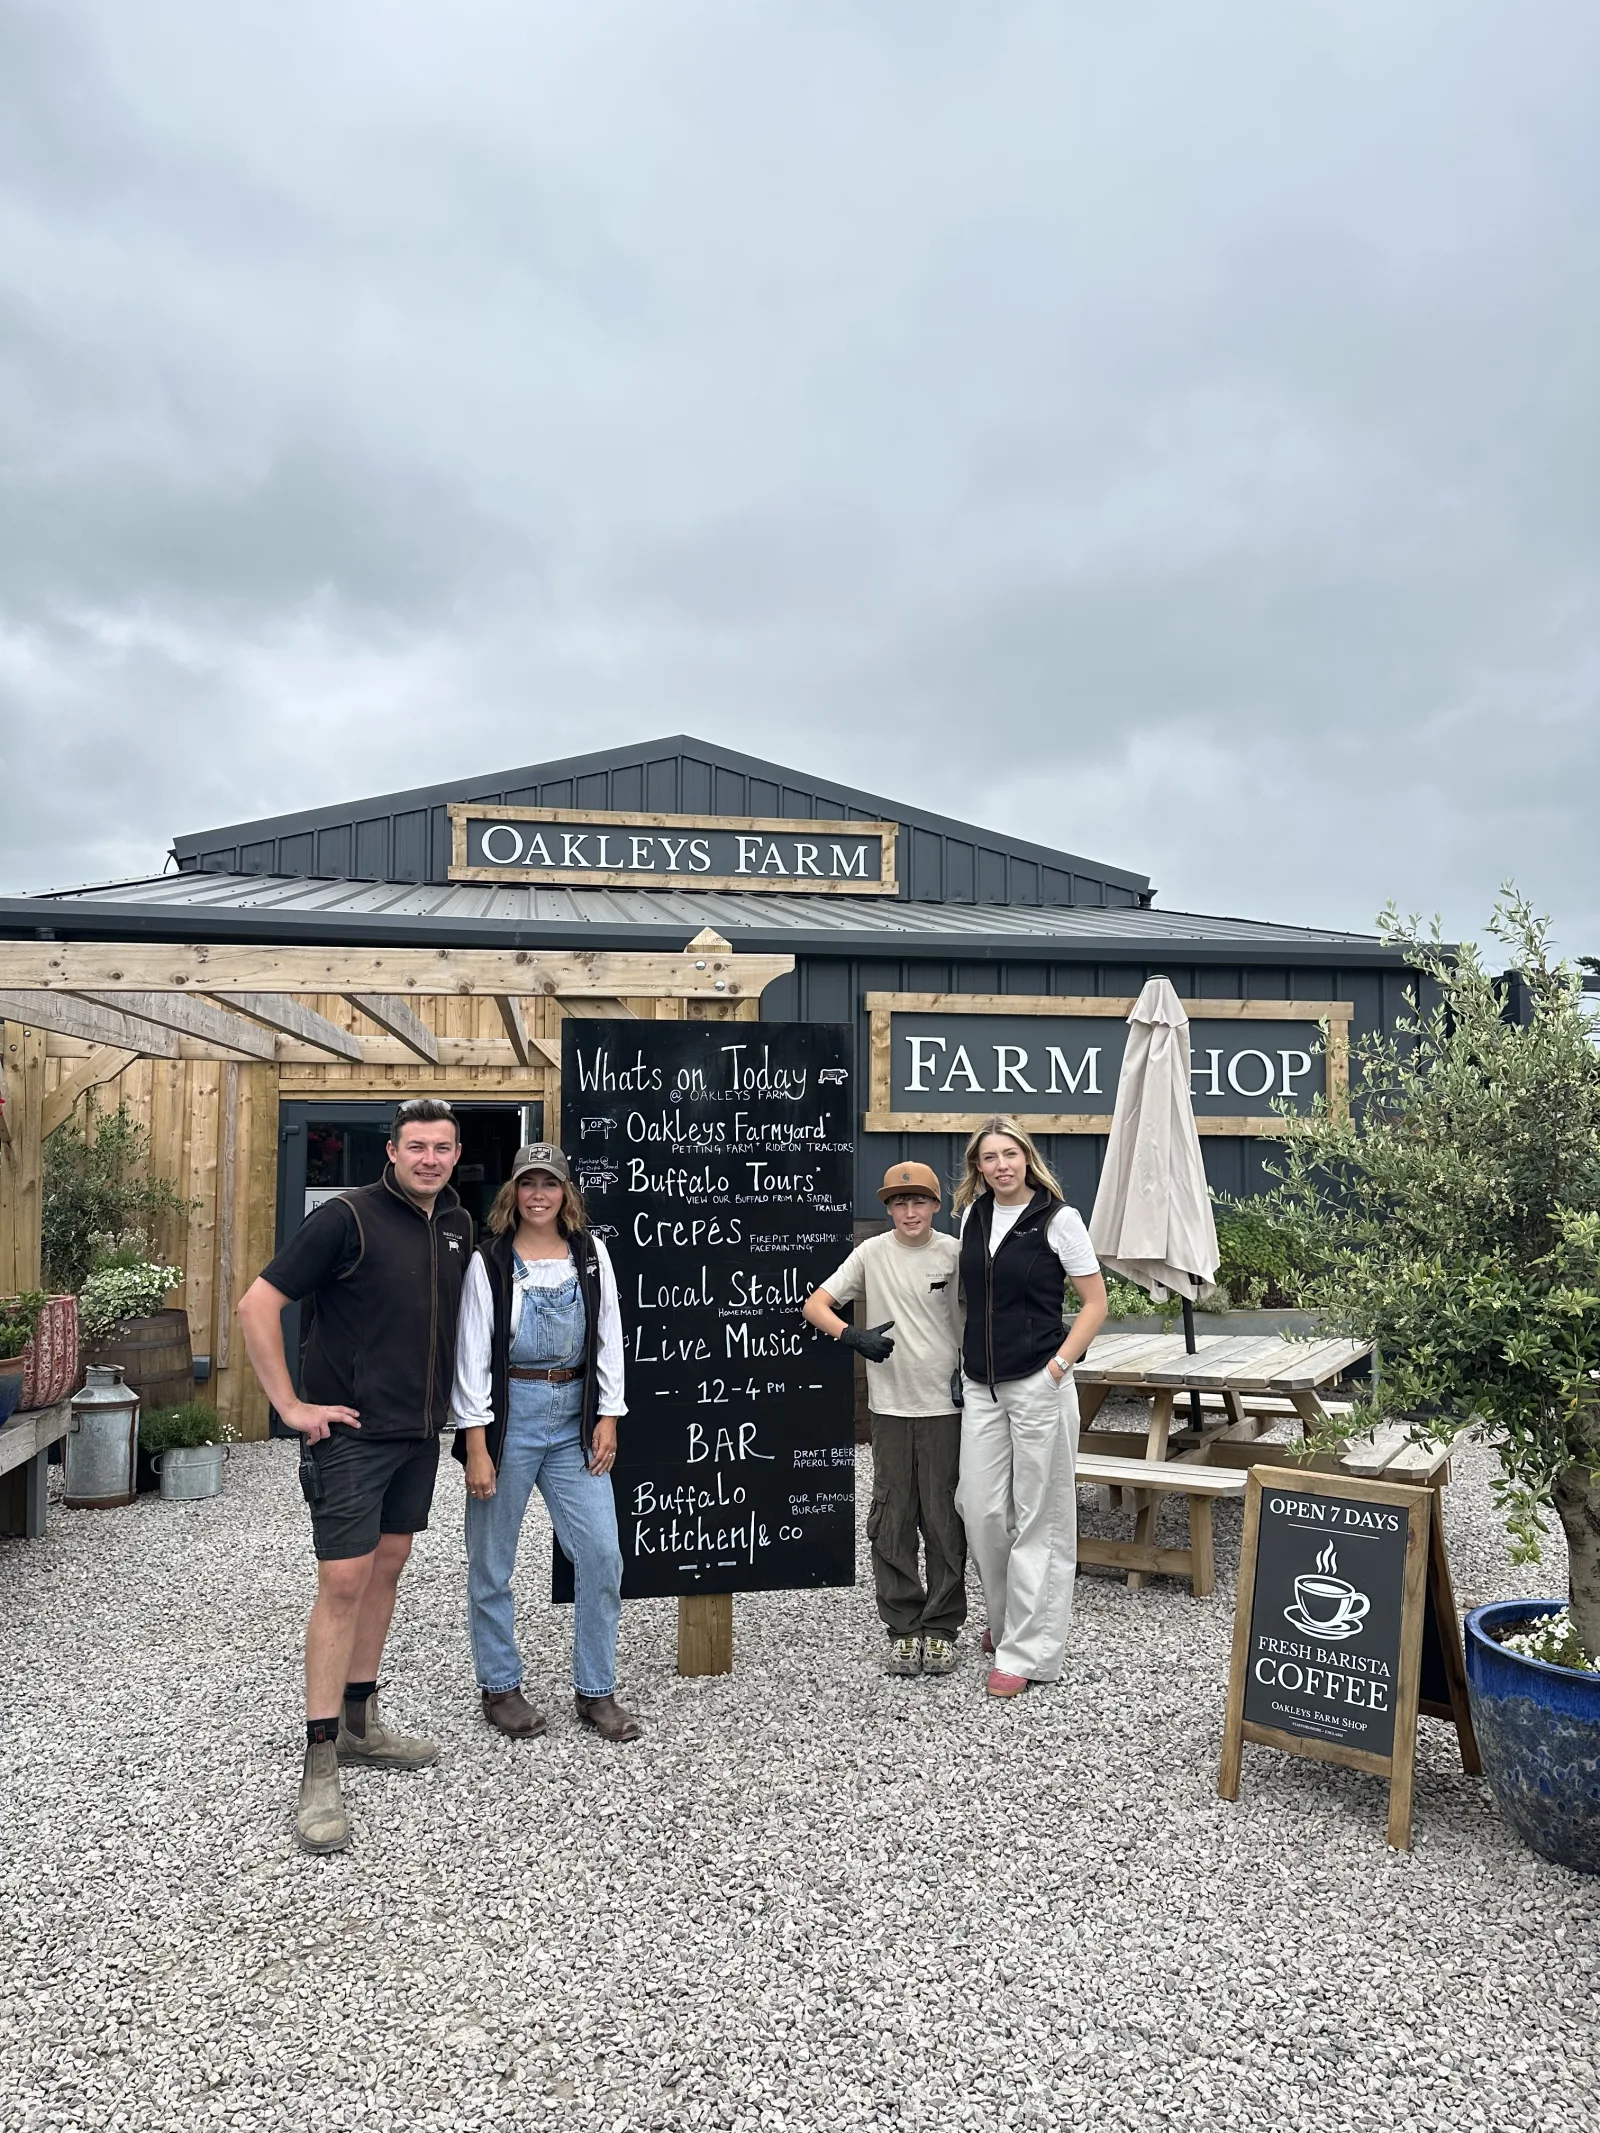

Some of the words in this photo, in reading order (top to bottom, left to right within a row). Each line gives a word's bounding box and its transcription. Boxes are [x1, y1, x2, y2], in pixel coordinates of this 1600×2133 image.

[481, 825, 712, 872] OAKLEYS
[734, 836, 869, 877] FARM
[576, 1046, 662, 1092] Whats
[677, 1067, 707, 1092] on
[721, 1044, 807, 1100] Today
[904, 1036, 1103, 1095] FARM
[1190, 1049, 1312, 1097] HOP
[669, 1089, 683, 1103] @
[690, 1089, 750, 1101] OAKLEYS
[758, 1089, 788, 1100] FARM
[627, 1109, 726, 1145] Oakleys
[672, 1144, 721, 1154] PETTING
[726, 1144, 754, 1153] FARM
[766, 1142, 786, 1152] RIDE
[806, 1142, 854, 1152] TRACTORS
[626, 1158, 729, 1197] Buffalo
[686, 1195, 708, 1204] VIEW
[713, 1195, 731, 1204] OUR
[735, 1194, 769, 1204] BUFFALO
[772, 1194, 793, 1203] FROM
[797, 1194, 804, 1203] A
[750, 1234, 790, 1244] FIREPIT
[750, 1244, 814, 1253] FACEPAINTING
[638, 1265, 714, 1308] Local
[718, 1308, 764, 1317] HOMEMADE
[635, 1325, 711, 1362] Live
[725, 1322, 803, 1358] Music
[767, 1382, 785, 1394] PM
[686, 1422, 775, 1463] BAR
[793, 1449, 827, 1459] DRAFT
[831, 1447, 855, 1458] BEER
[793, 1459, 829, 1468] APEROL
[631, 1471, 746, 1516] Buffalo
[788, 1493, 810, 1504] OUR
[816, 1492, 854, 1502] FAMOUS
[791, 1504, 836, 1515] BURGER
[1269, 1498, 1326, 1521] OPEN
[1330, 1505, 1341, 1522] 7
[1344, 1508, 1399, 1532] DAYS
[1258, 1635, 1312, 1660] FRESH
[1315, 1648, 1391, 1678] BARISTA
[1255, 1657, 1388, 1712] COFFEE
[1271, 1701, 1311, 1718] OAKLEYS
[1314, 1711, 1340, 1725] FARM
[1342, 1717, 1368, 1732] SHOP
